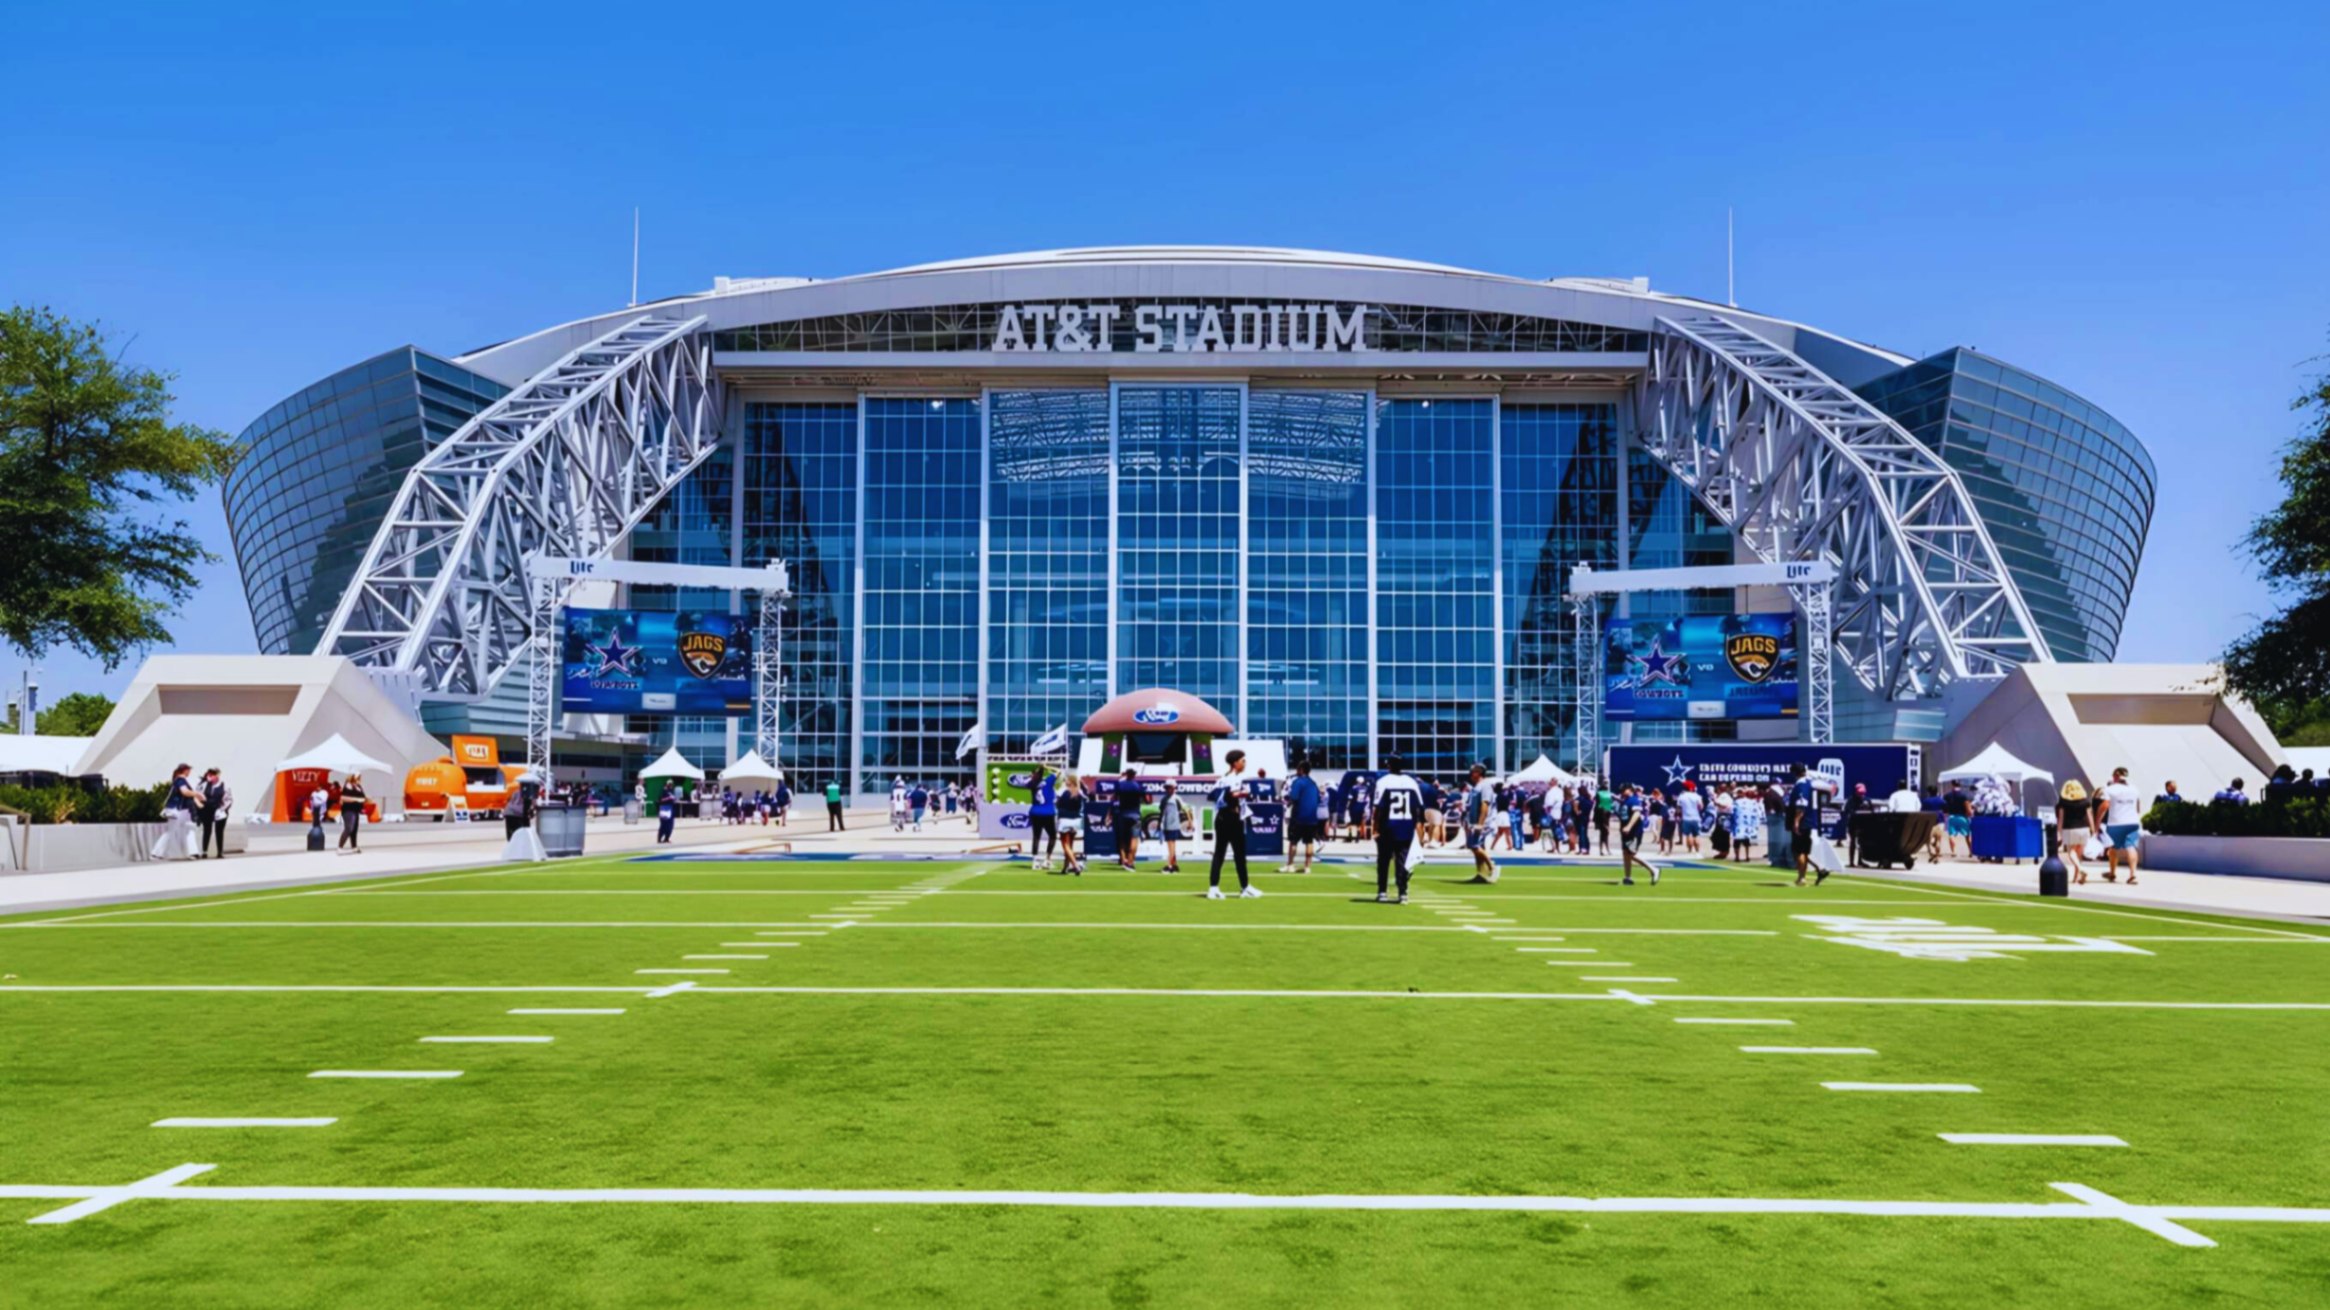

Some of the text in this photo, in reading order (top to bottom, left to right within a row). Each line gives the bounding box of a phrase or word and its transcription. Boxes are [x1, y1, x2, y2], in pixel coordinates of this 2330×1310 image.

[992, 304, 1368, 352] AT&T STADIUM
[570, 560, 595, 575] Lite
[1786, 564, 1812, 579] Lite
[682, 632, 724, 653] JAGS
[1730, 636, 1777, 655] JAGS
[1389, 791, 1412, 820] 21
